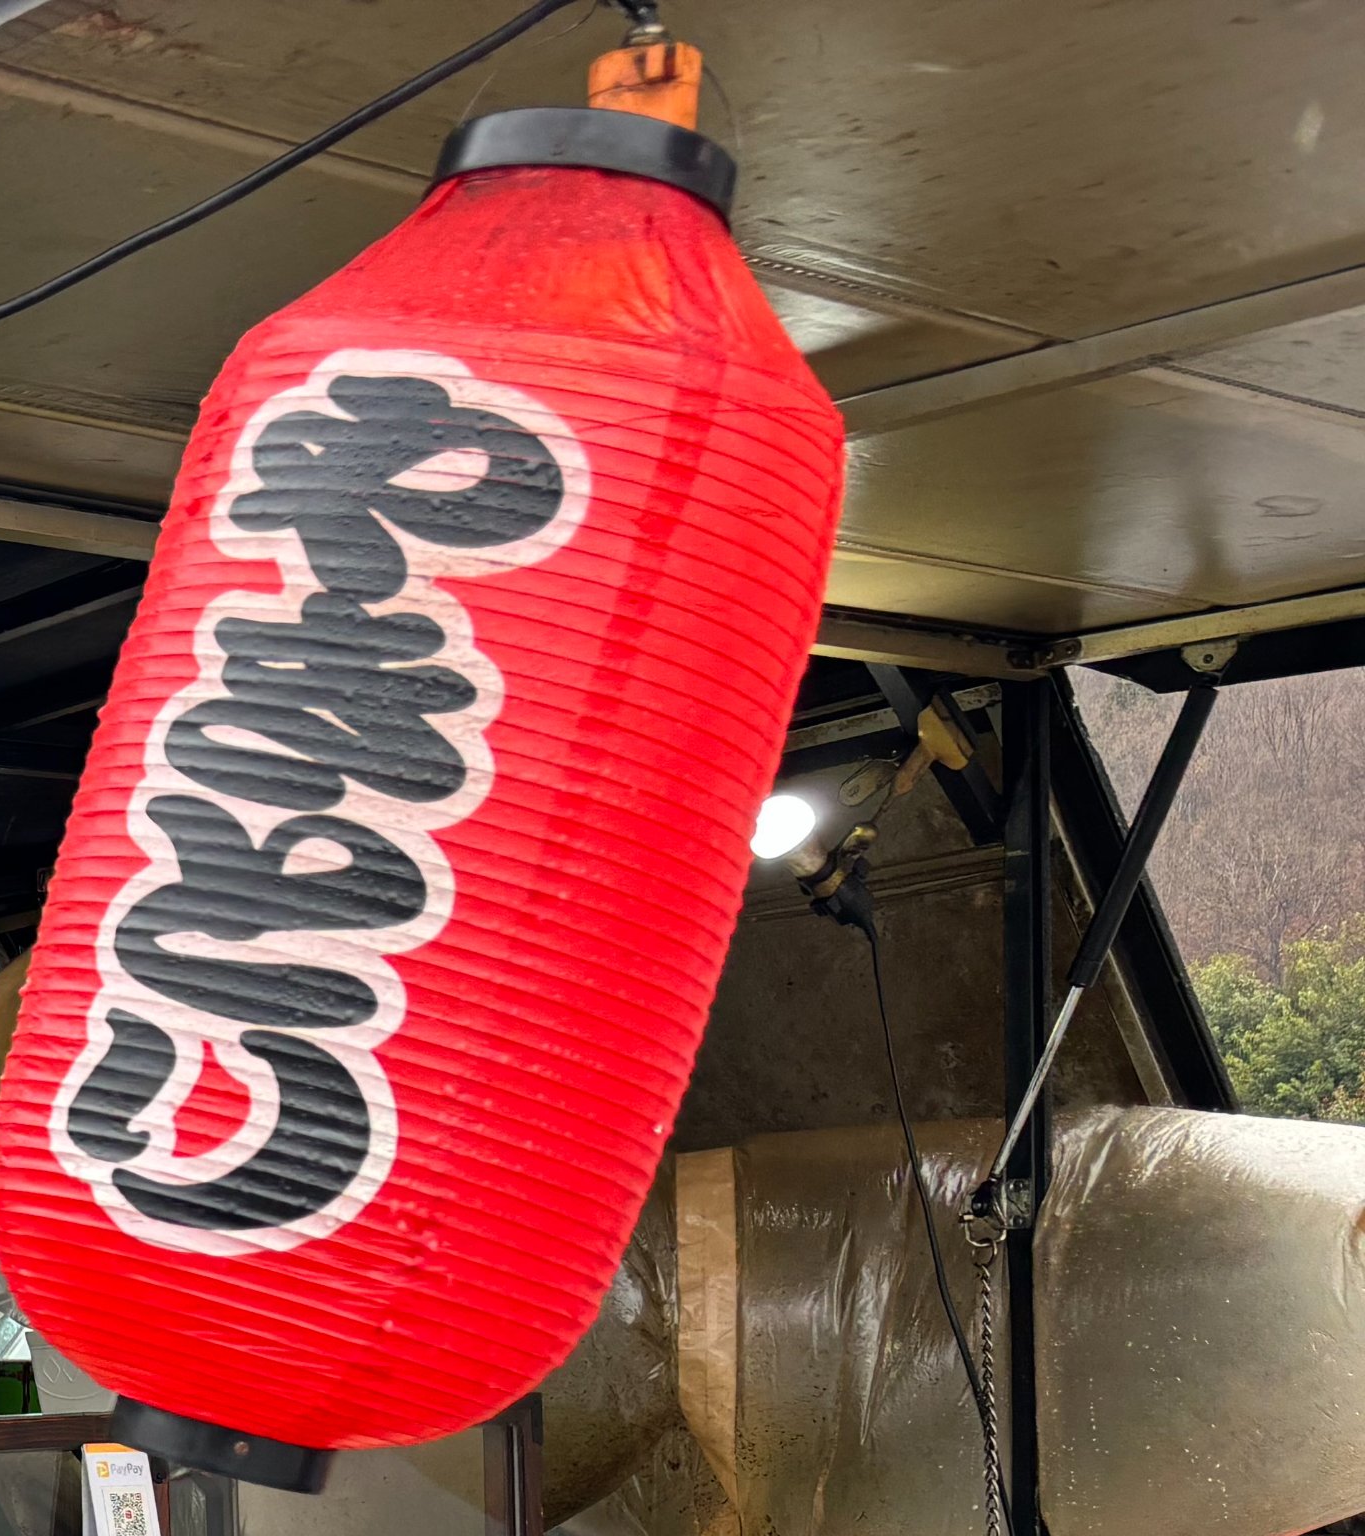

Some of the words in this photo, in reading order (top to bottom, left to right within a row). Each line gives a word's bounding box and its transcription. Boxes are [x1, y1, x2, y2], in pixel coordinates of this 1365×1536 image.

[68, 374, 563, 1230] やきとり
[110, 1462, 143, 1476] PayPay
